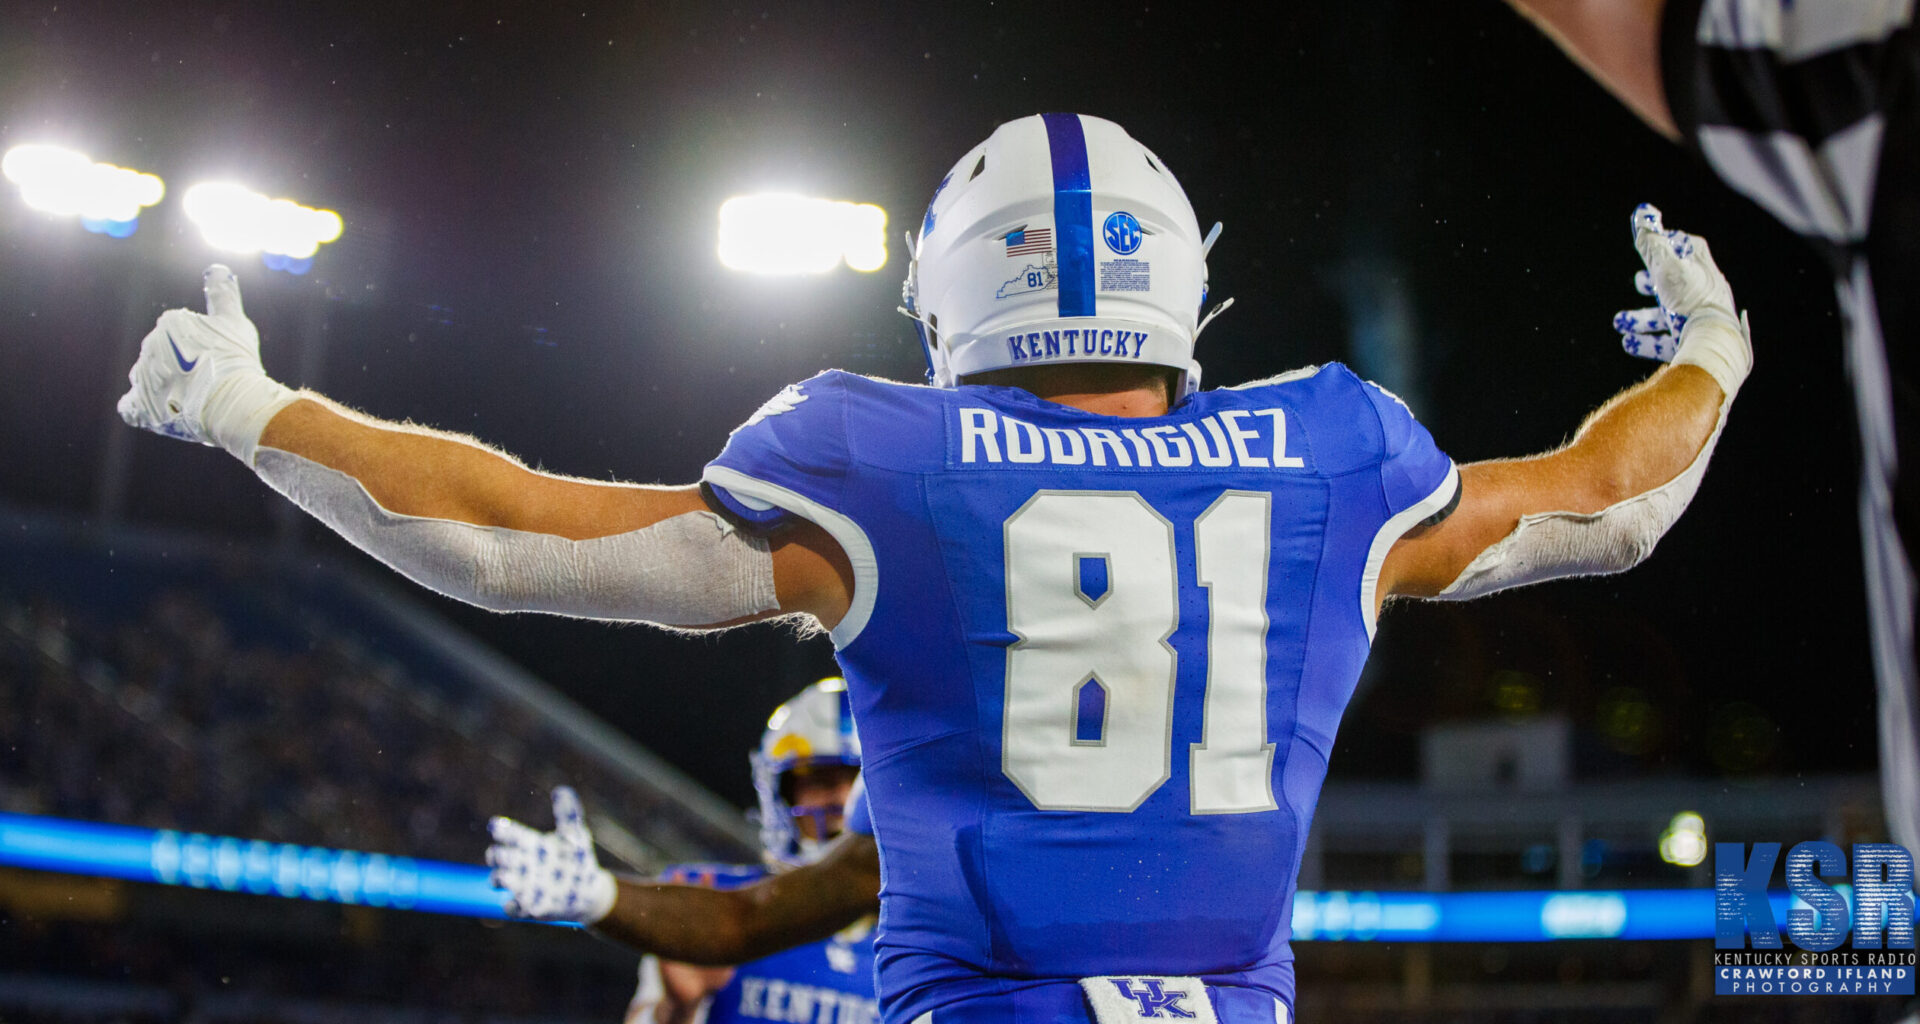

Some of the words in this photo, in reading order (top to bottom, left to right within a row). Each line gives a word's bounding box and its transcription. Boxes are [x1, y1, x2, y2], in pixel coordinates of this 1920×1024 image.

[1106, 213, 1140, 253] SEC
[1027, 272, 1043, 288] 81
[1009, 329, 1148, 360] KENTUCKY
[959, 408, 1304, 468] RODRIGUEZ
[1002, 489, 1279, 815] 81
